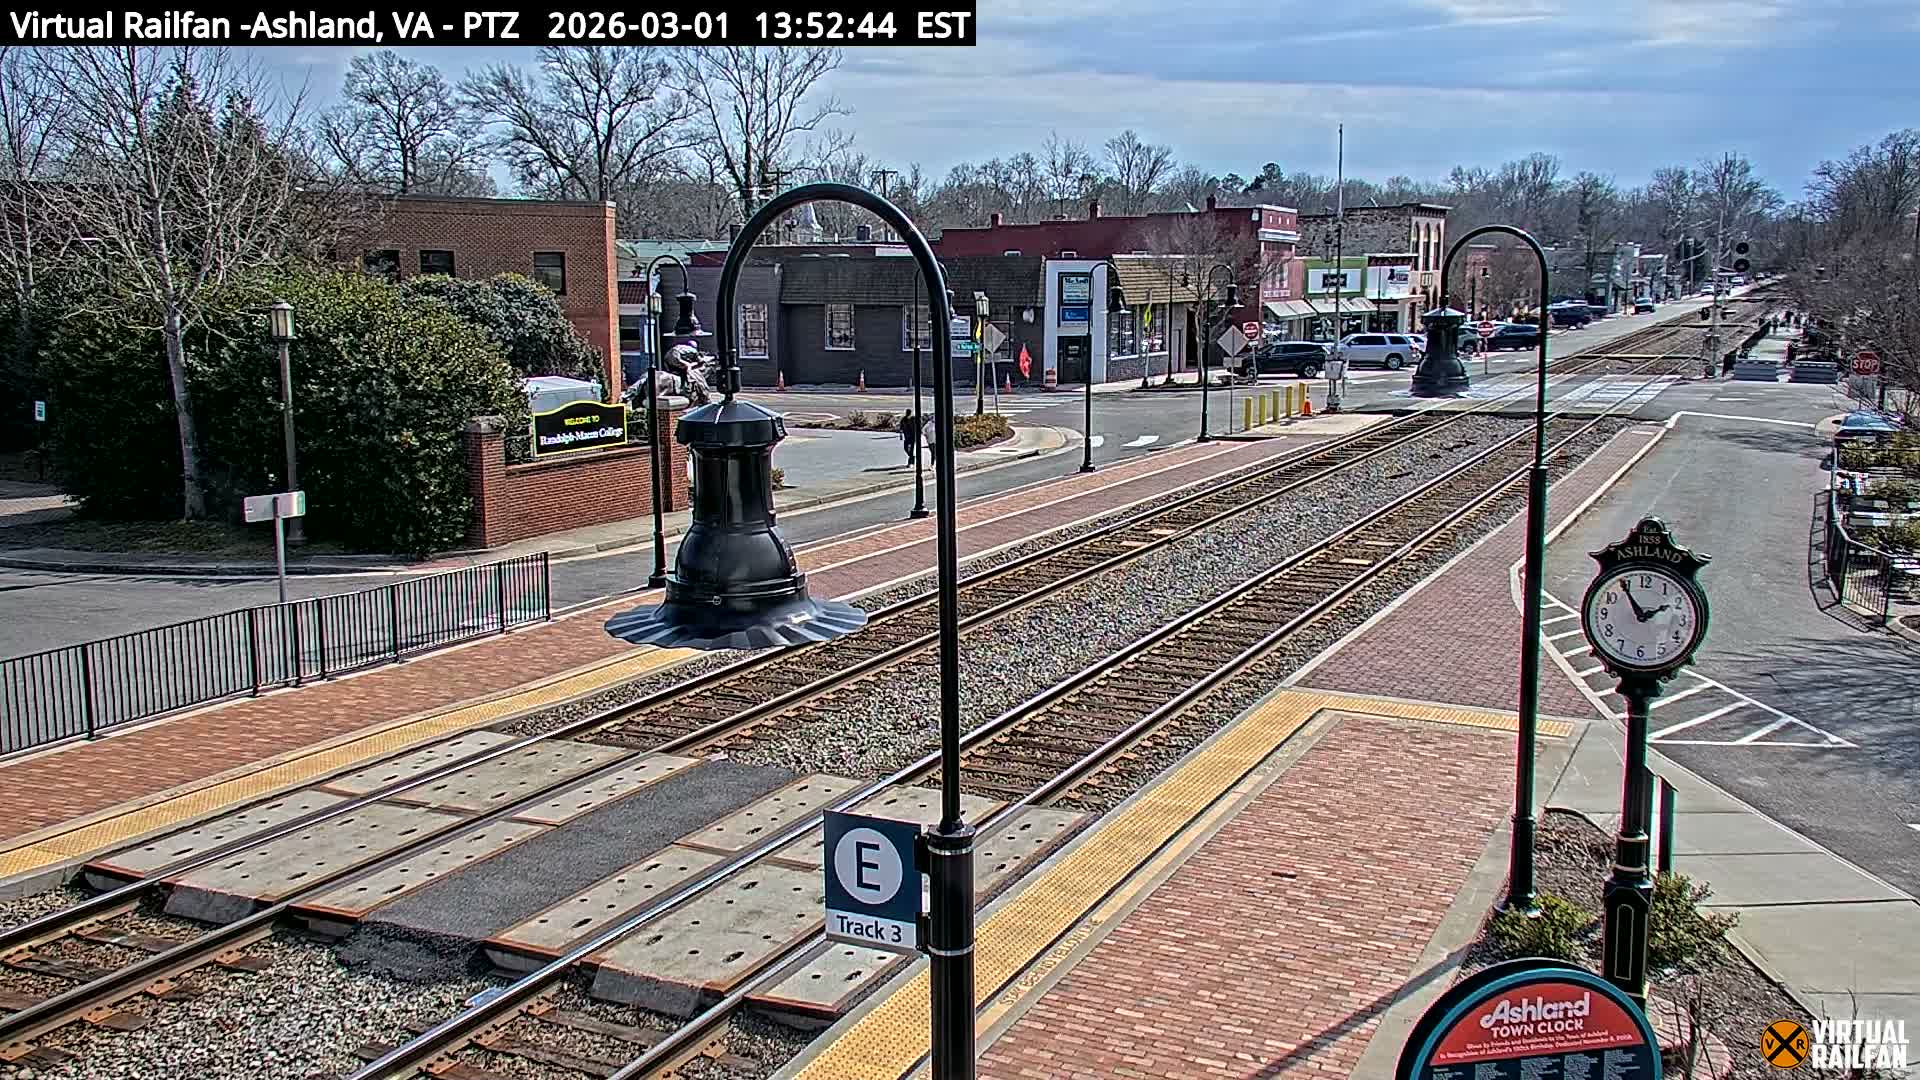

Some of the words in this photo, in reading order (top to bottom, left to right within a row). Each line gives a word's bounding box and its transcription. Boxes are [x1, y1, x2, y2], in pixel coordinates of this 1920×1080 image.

[1852, 359, 1878, 369] STOP
[1617, 545, 1681, 563] ASHLAND
[1640, 575, 1652, 589] 12
[1663, 583, 1667, 595] 1
[1606, 591, 1618, 605] 10
[1674, 597, 1682, 610] 2
[1600, 607, 1608, 620] 9
[1679, 615, 1686, 627] 3
[1604, 623, 1614, 637] 8
[1672, 630, 1680, 643] 4
[1617, 639, 1624, 651] 7
[1637, 645, 1644, 657] 6
[1657, 643, 1666, 655] 5
[855, 841, 881, 891] E
[836, 914, 885, 940] Track
[891, 925, 902, 943] 3
[1480, 991, 1591, 1029] Ashland
[1490, 1023, 1535, 1039] TOWN
[1537, 1018, 1584, 1035] CLOCK
